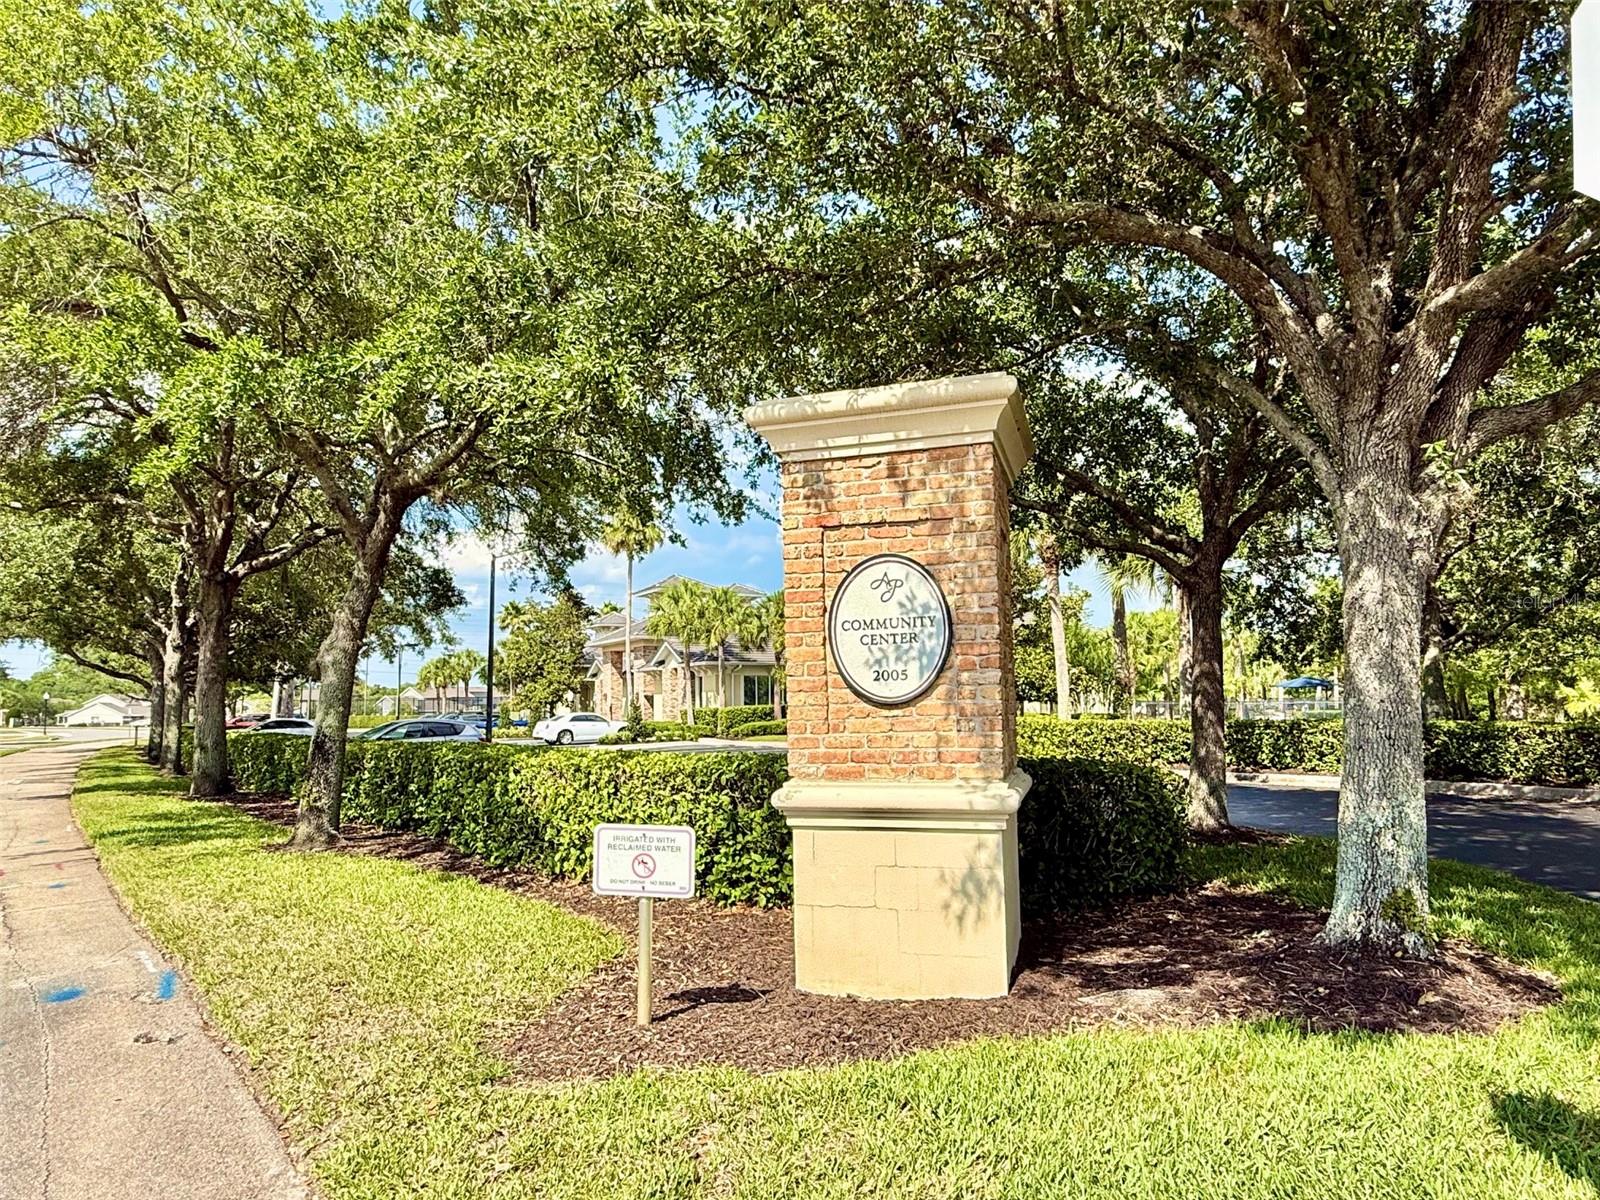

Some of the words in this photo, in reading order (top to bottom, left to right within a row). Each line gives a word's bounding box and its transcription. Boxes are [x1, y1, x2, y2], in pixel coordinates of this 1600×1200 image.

[841, 615, 937, 632] COMMUNITY
[860, 632, 919, 646] CENTER
[873, 669, 908, 682] 2005
